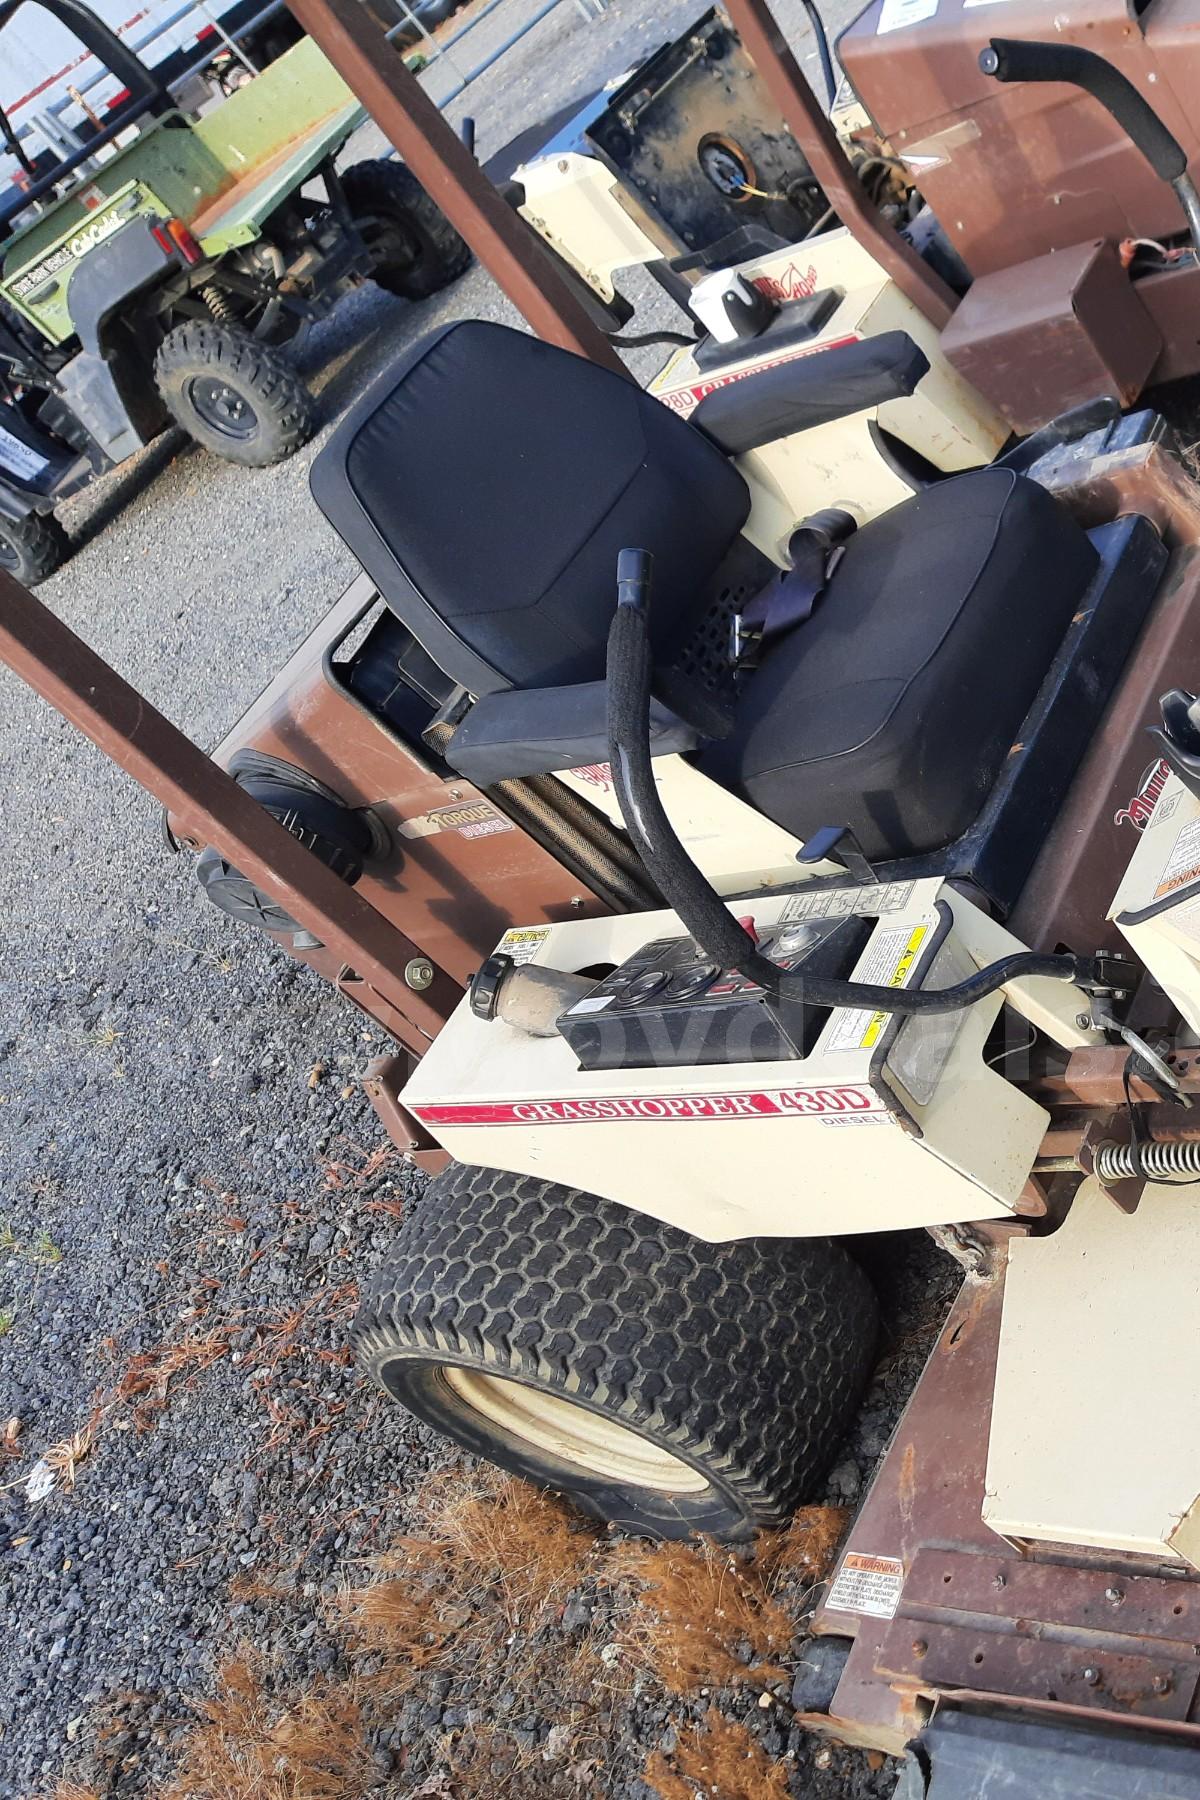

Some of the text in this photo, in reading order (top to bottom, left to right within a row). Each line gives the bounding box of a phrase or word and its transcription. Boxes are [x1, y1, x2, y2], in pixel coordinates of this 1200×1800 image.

[434, 803, 496, 829] TORQUE
[463, 819, 513, 838] DIESEL
[513, 1095, 762, 1122] GRASSHOPPER
[778, 1088, 872, 1117] 430D
[822, 1116, 884, 1126] DIESEL
[859, 1559, 901, 1573] WARNING
